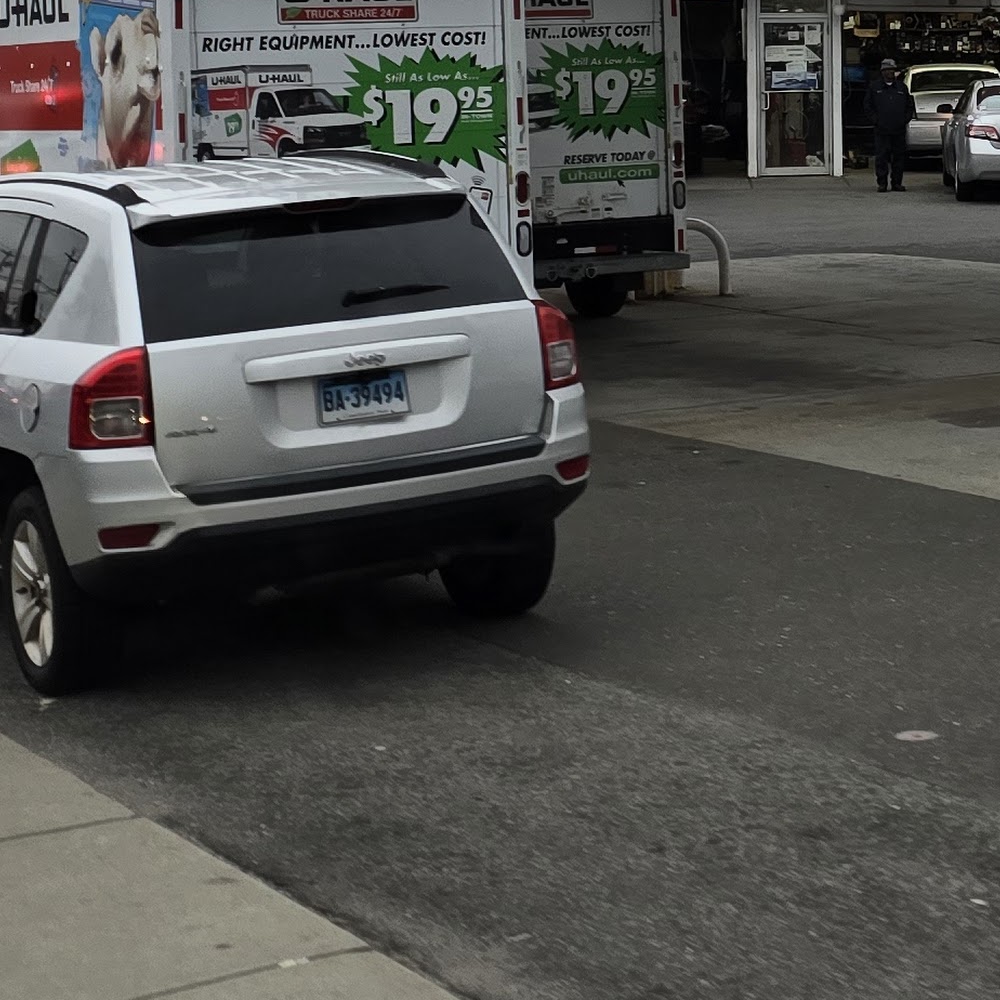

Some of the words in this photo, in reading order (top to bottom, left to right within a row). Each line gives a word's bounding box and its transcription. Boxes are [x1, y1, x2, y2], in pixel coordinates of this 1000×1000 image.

[305, 8, 340, 20] TRUCK
[342, 8, 378, 19] SHARE
[379, 7, 402, 18] 24/7
[615, 25, 651, 38] COST!
[202, 36, 254, 53] RIGHT
[441, 31, 486, 46] COST!
[572, 57, 589, 66] Still
[591, 57, 602, 66] As
[604, 56, 622, 65] Low
[211, 75, 242, 86] U-HAUL
[258, 74, 304, 84] U-HAUL
[385, 72, 406, 84] Still
[409, 73, 424, 83] As
[427, 72, 450, 82] Low
[564, 153, 607, 165] RESERVE
[610, 151, 646, 163] TODAY
[568, 167, 652, 182] uhaul.com
